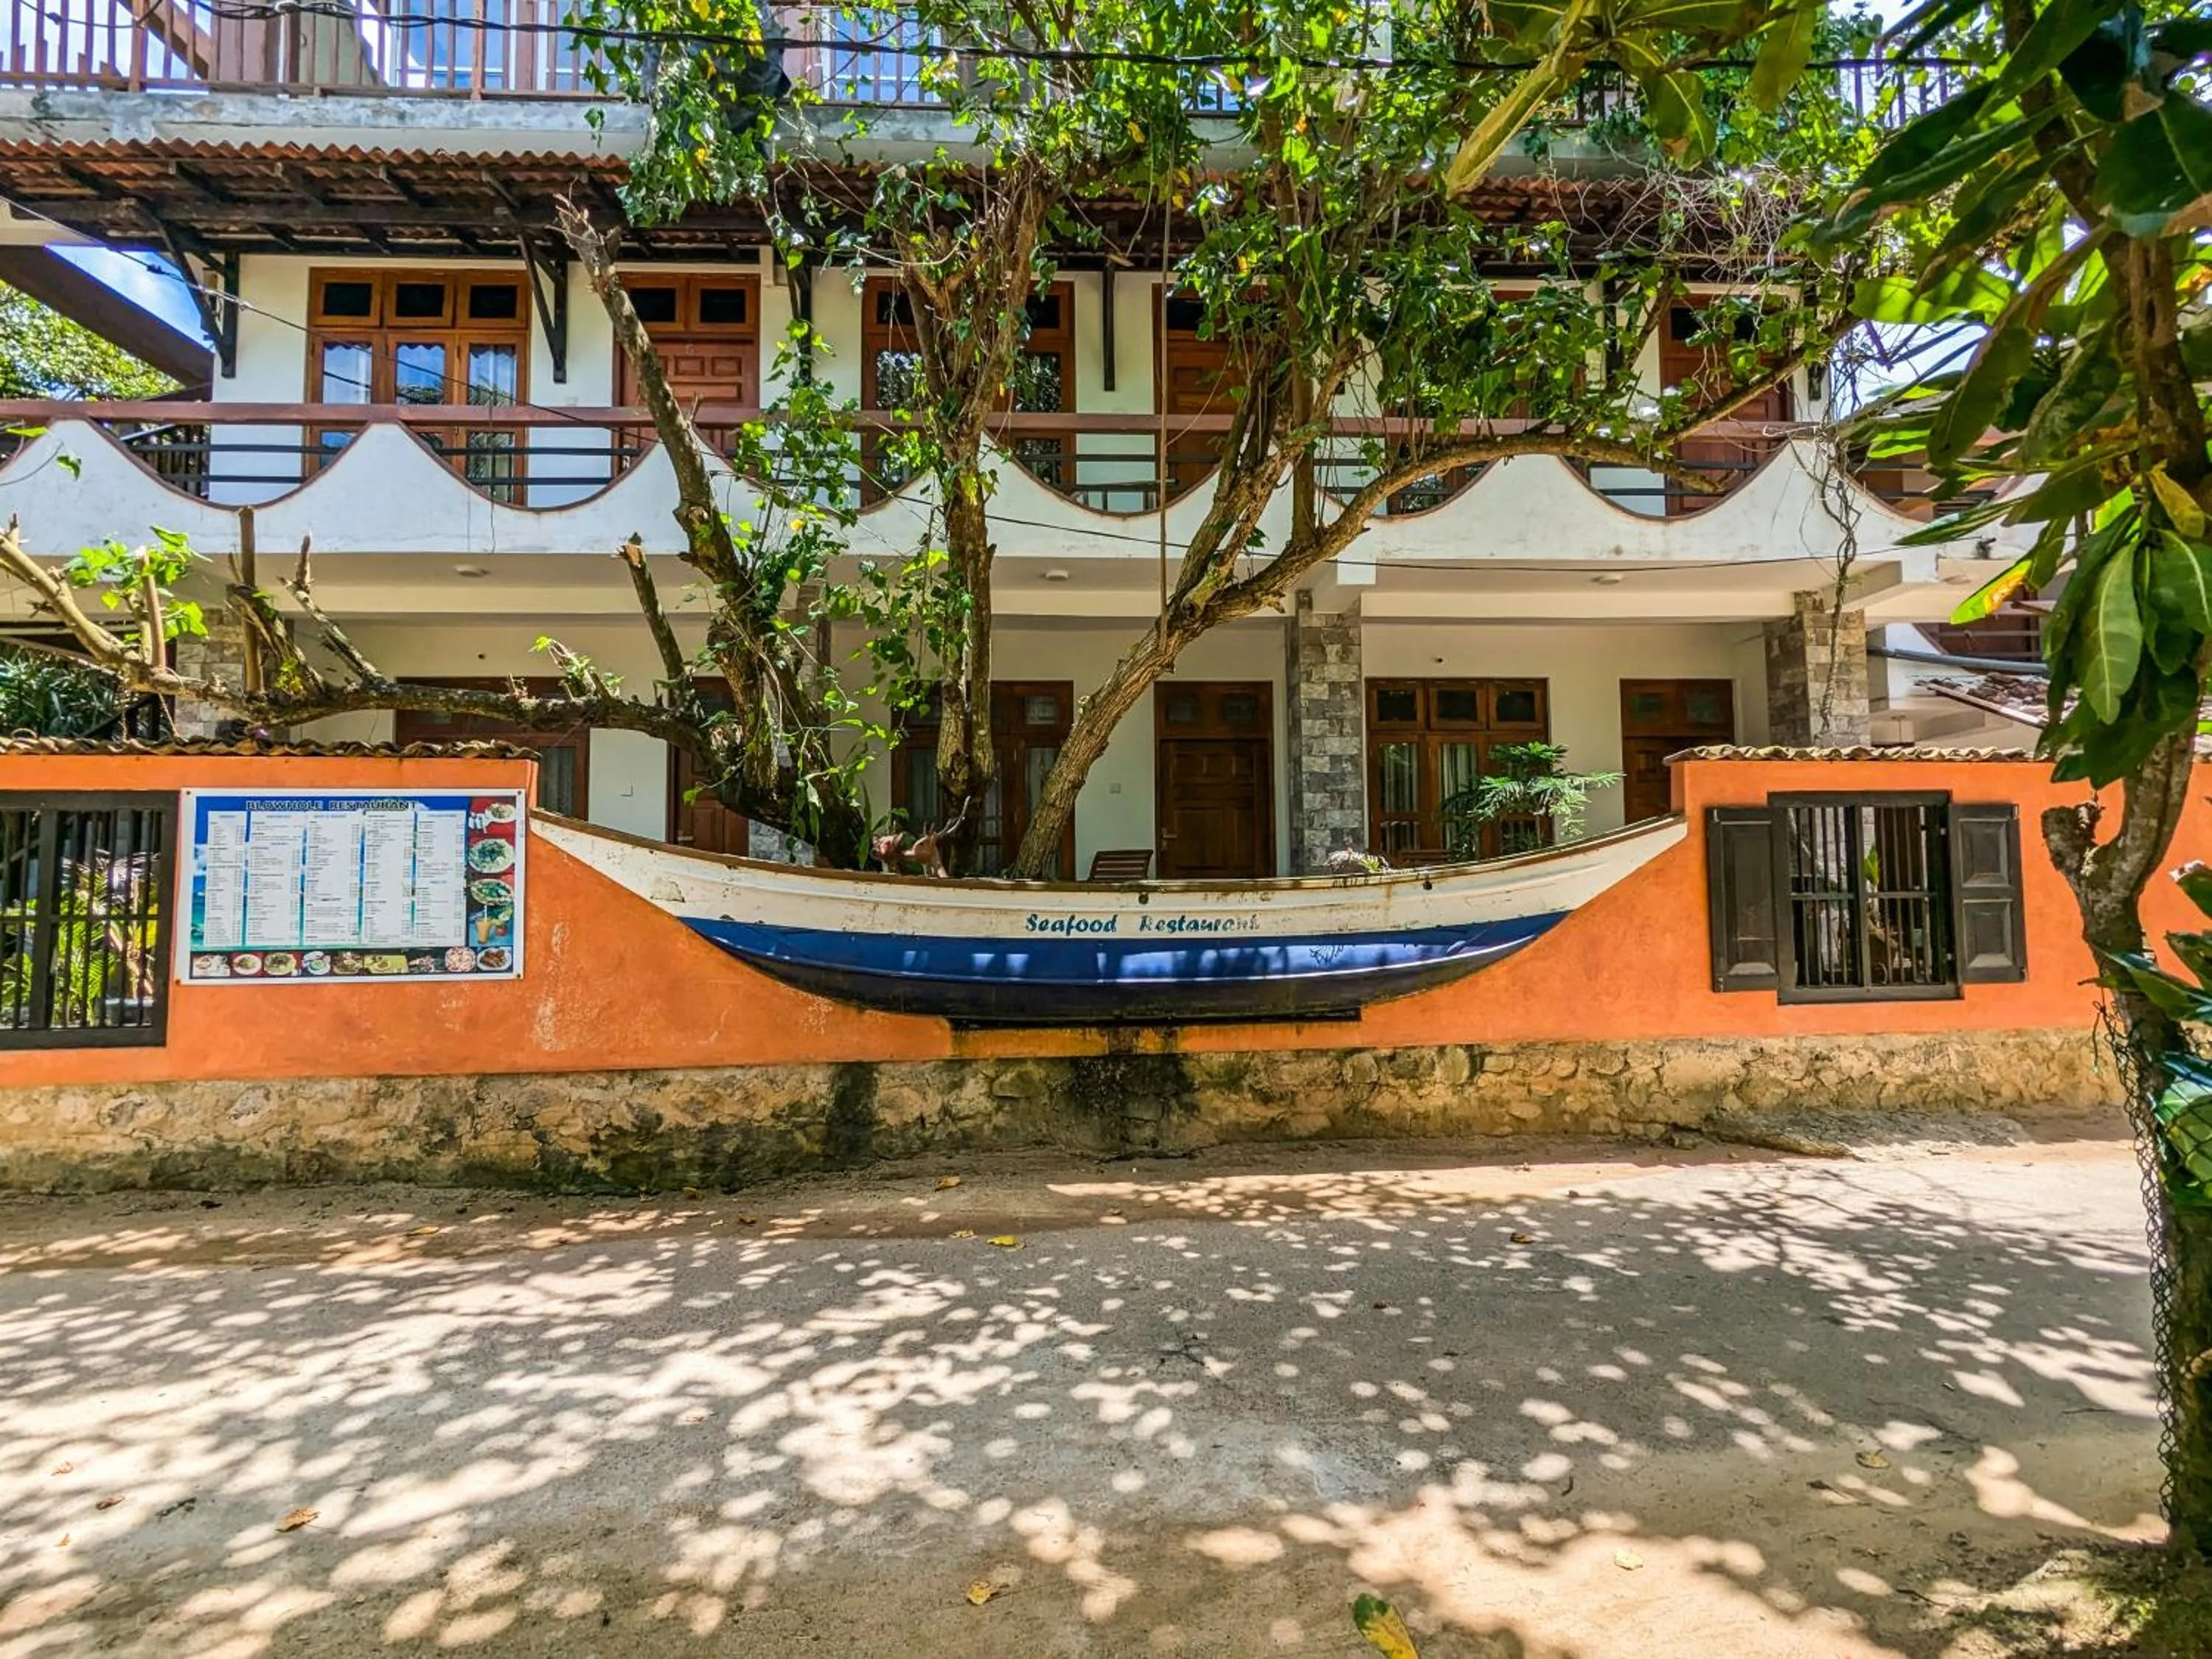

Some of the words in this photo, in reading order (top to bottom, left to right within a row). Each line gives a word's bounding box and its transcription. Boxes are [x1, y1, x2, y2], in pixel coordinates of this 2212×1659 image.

[246, 800, 324, 812] BLOWHOLE
[329, 800, 416, 812] RESTAURANT
[1026, 914, 1119, 936] Seafood
[1139, 914, 1261, 933] Restaurant
